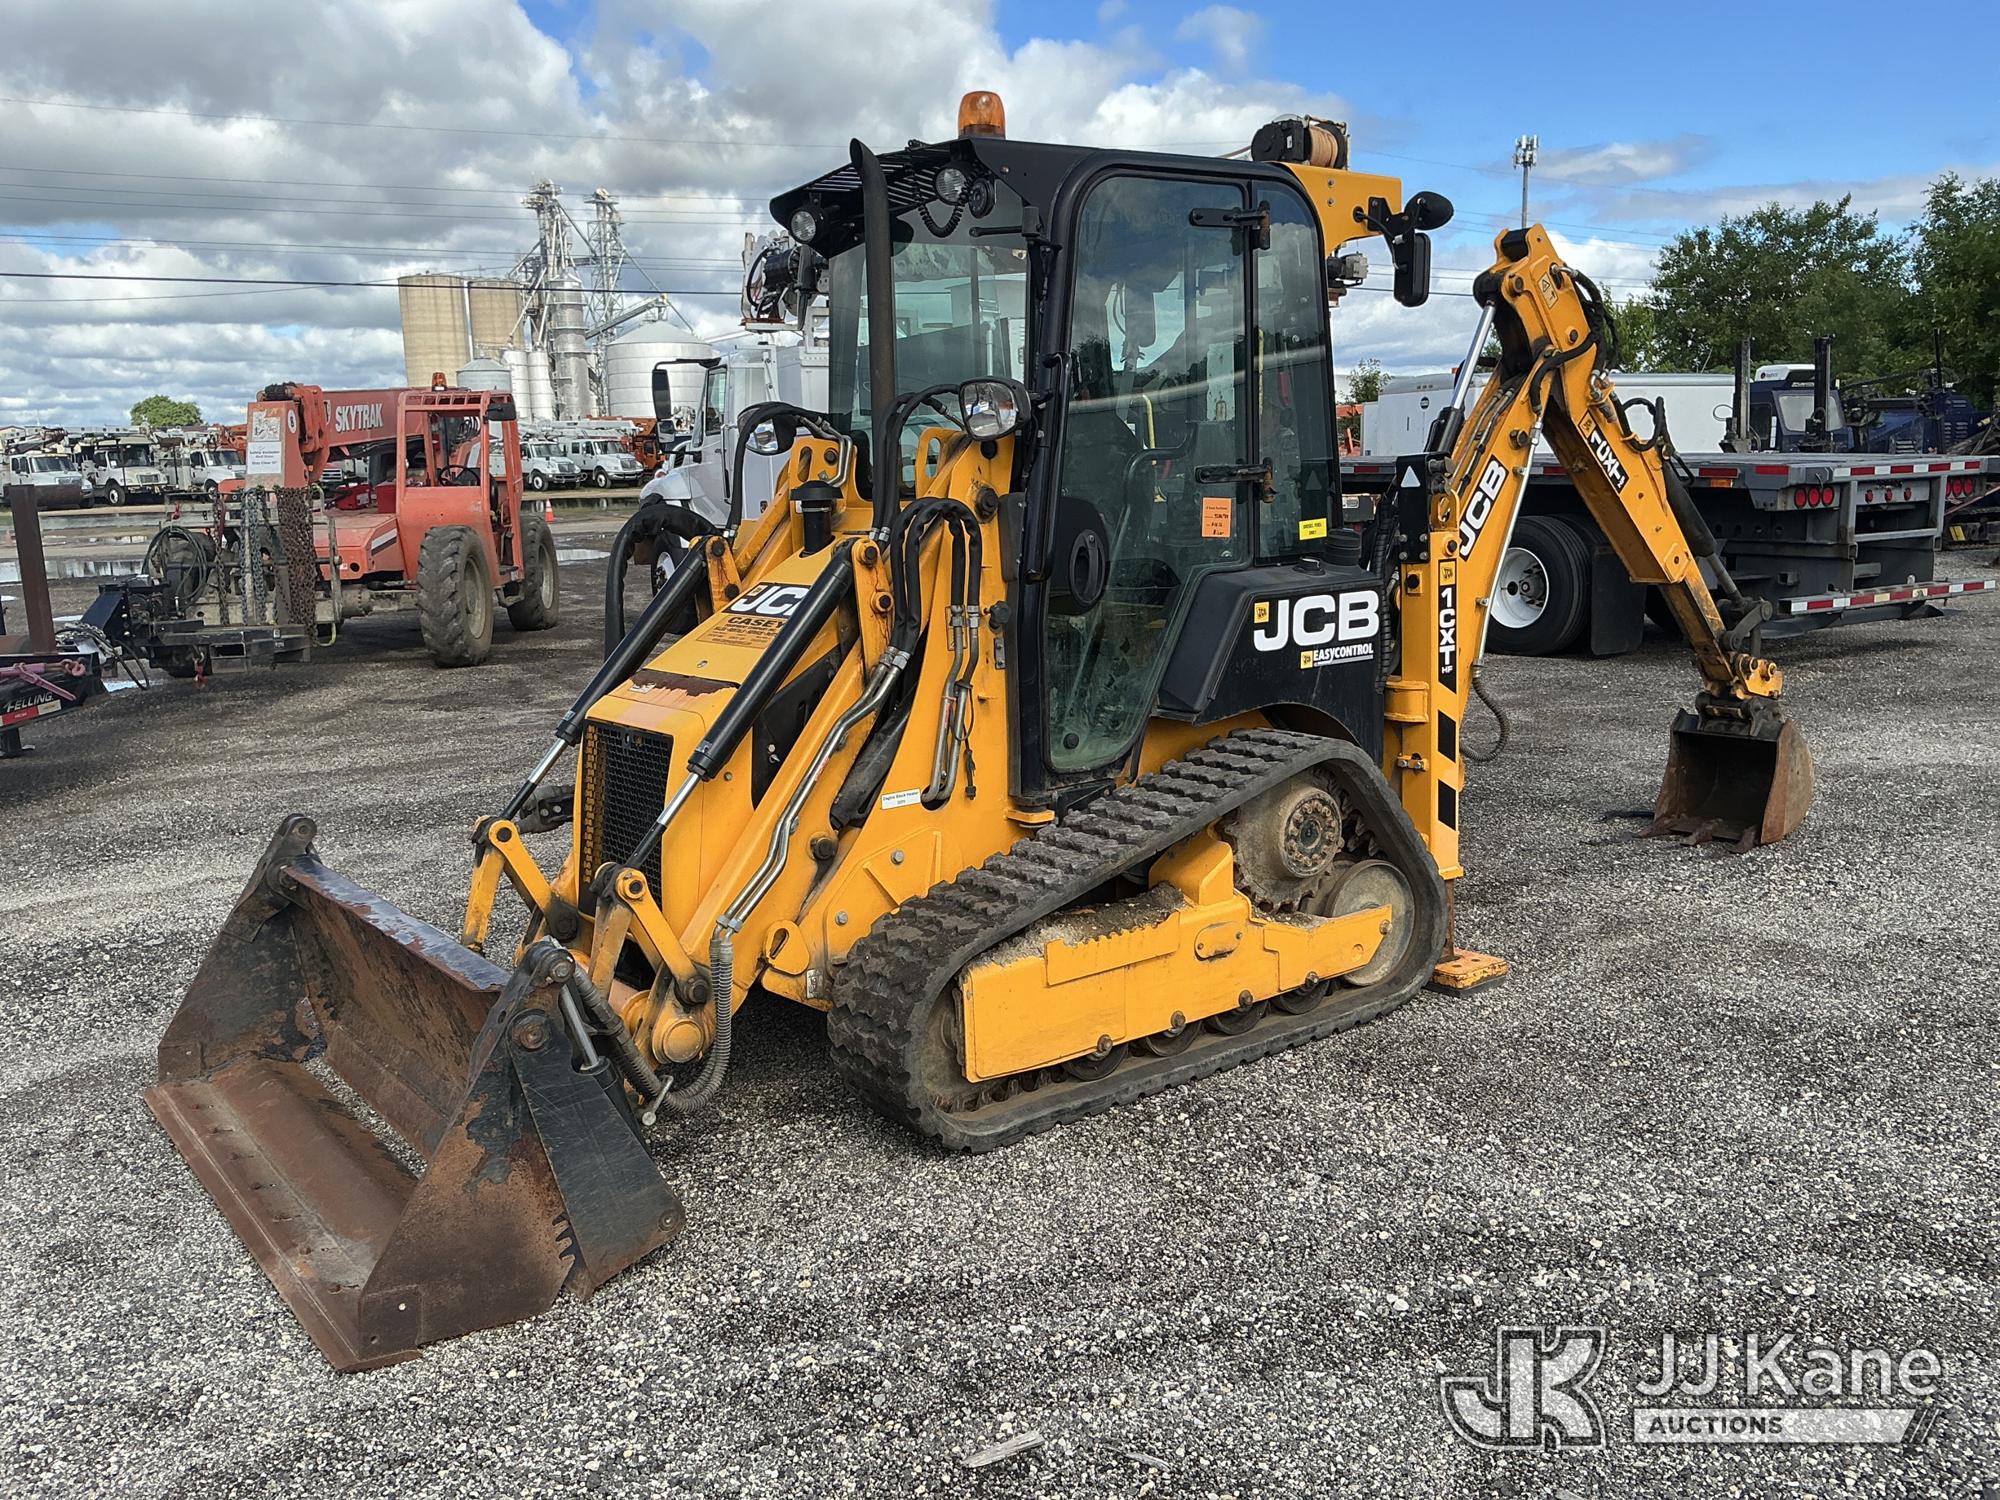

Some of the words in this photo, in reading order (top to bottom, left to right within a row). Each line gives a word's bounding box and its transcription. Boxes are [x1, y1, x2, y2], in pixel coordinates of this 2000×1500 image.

[335, 403, 384, 433] SKYTRAK
[1459, 460, 1507, 557] JCB
[730, 585, 810, 616] JC
[727, 616, 786, 628] CASEY
[1253, 590, 1380, 652] JCB
[1439, 587, 1456, 665] 1CXT
[1313, 643, 1374, 662] EASYCONTROL
[1441, 665, 1453, 674] HF
